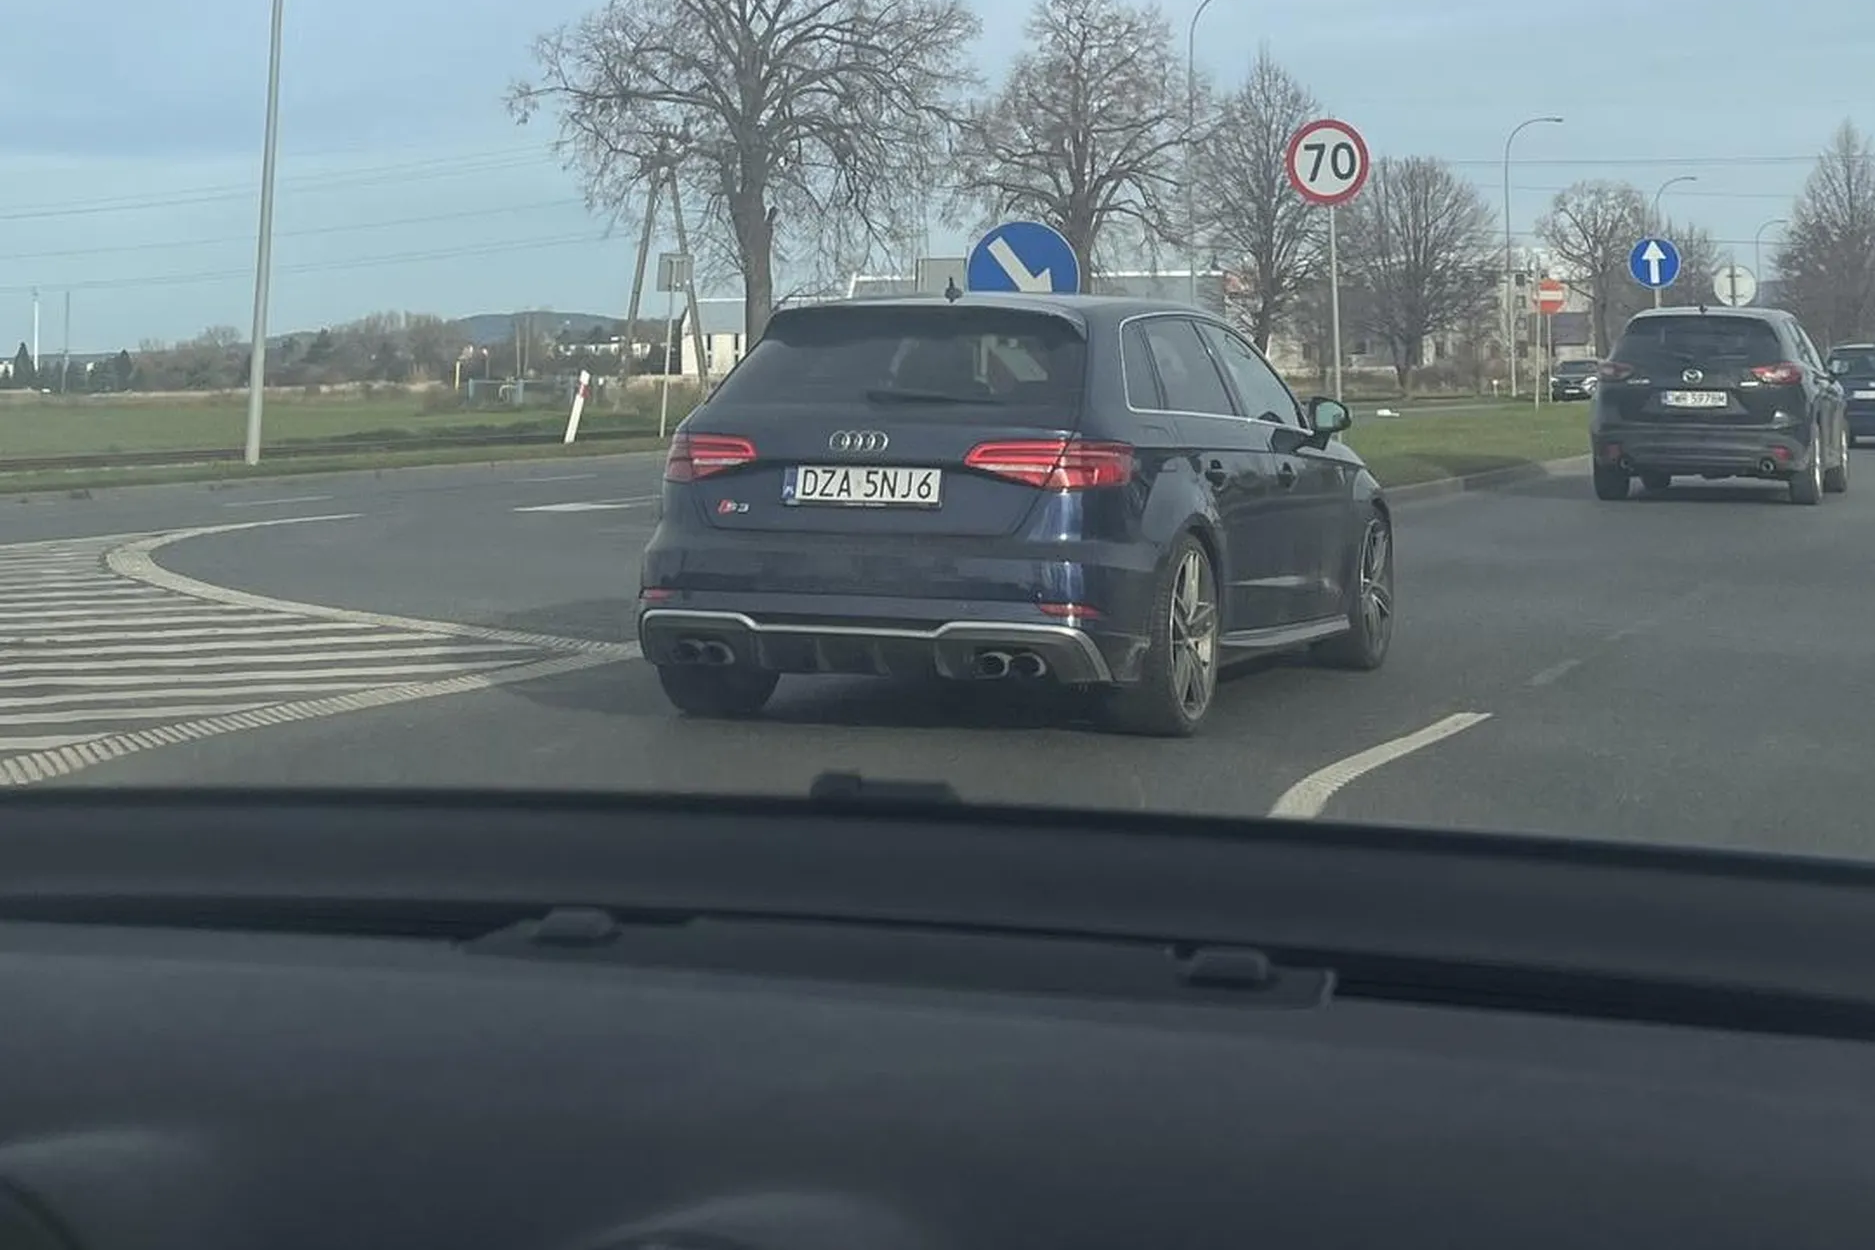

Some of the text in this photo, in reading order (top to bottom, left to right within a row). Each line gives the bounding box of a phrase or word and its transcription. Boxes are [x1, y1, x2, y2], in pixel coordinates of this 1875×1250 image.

[1304, 142, 1356, 182] 70
[802, 469, 933, 499] DZA 5NJ6
